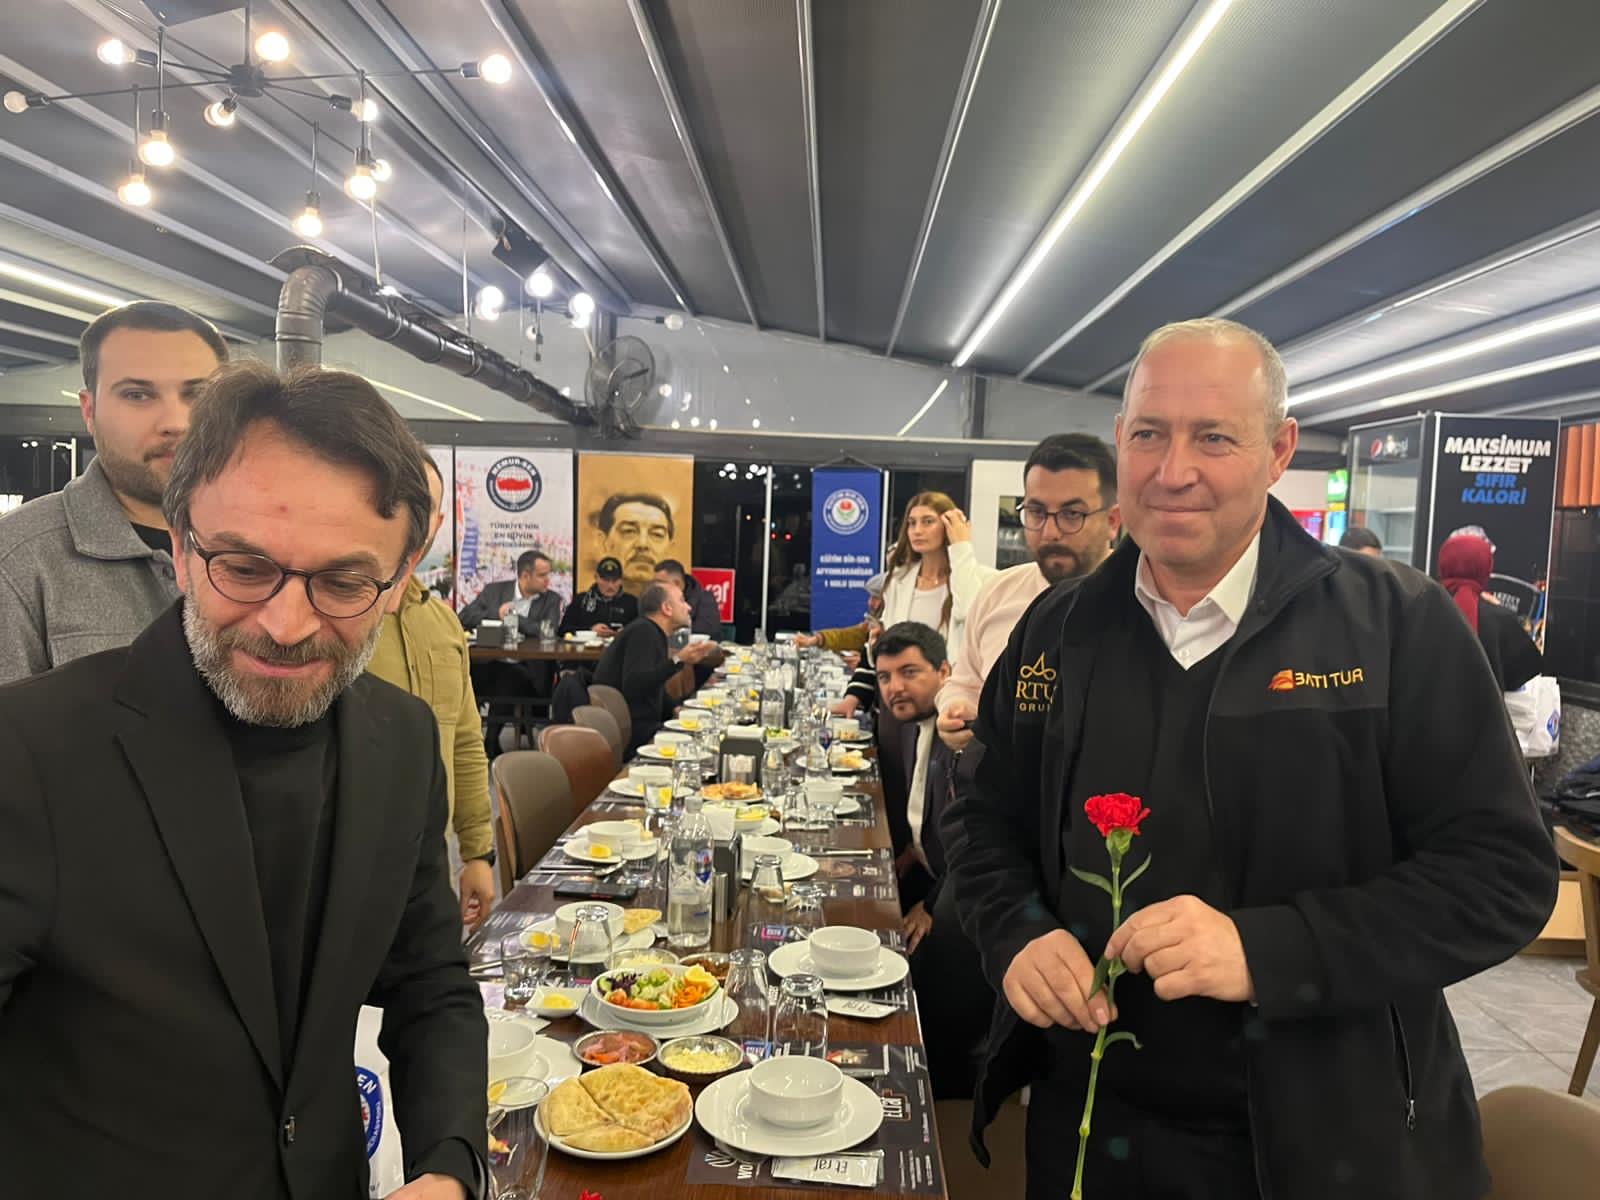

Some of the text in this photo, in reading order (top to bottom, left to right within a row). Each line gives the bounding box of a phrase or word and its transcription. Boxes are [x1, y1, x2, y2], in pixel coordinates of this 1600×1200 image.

[1444, 433, 1552, 456] MAKSİMUM
[1460, 455, 1533, 474] LEZZET
[1475, 473, 1517, 488] SIFIR
[1461, 488, 1527, 505] KALORİ
[1295, 667, 1364, 689] BATI TUR
[1018, 702, 1051, 713] GRU
